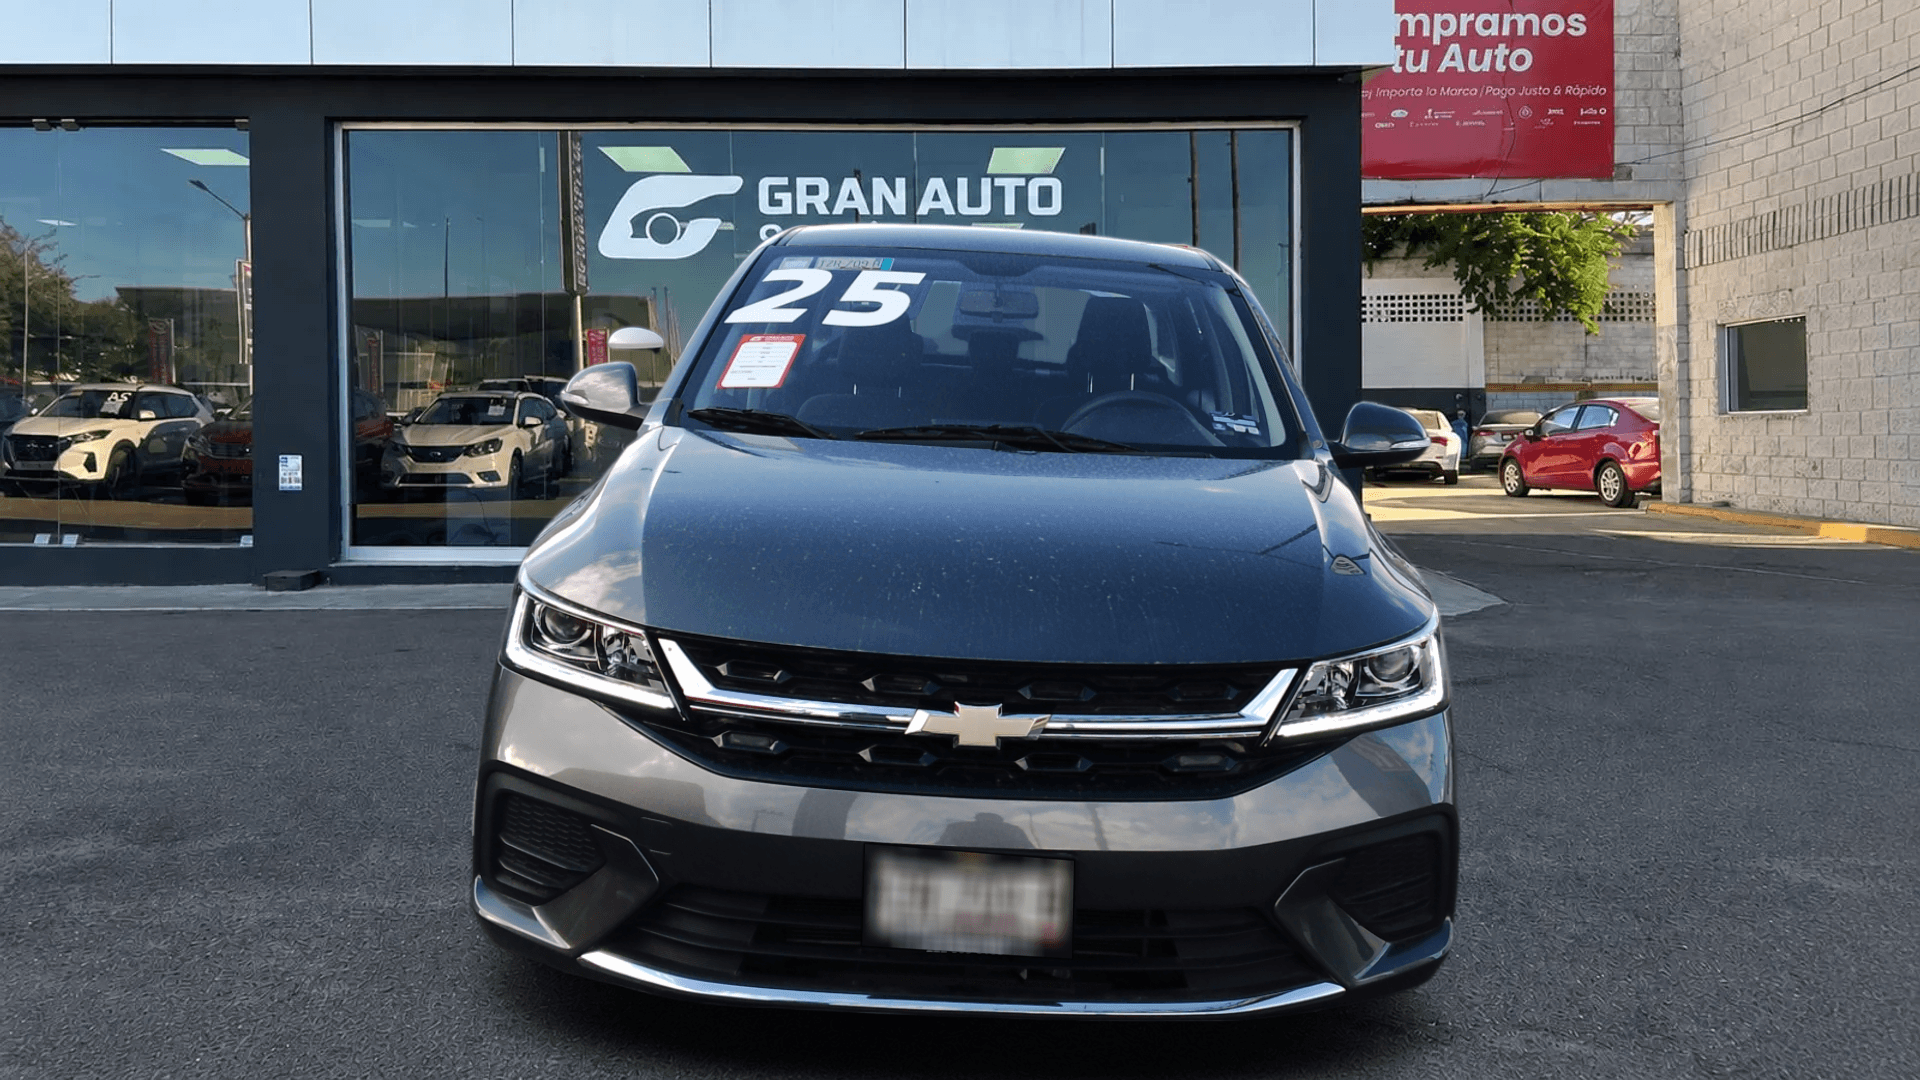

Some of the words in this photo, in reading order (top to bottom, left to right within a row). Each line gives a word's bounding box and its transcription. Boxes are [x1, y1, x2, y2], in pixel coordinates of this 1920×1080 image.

[1392, 44, 1430, 73] tu
[1437, 43, 1533, 73] Auto
[1518, 85, 1551, 97] Justo
[1553, 85, 1562, 96] &
[758, 176, 909, 216] GRAN
[917, 176, 1063, 216] AUTO
[724, 269, 927, 327] 25
